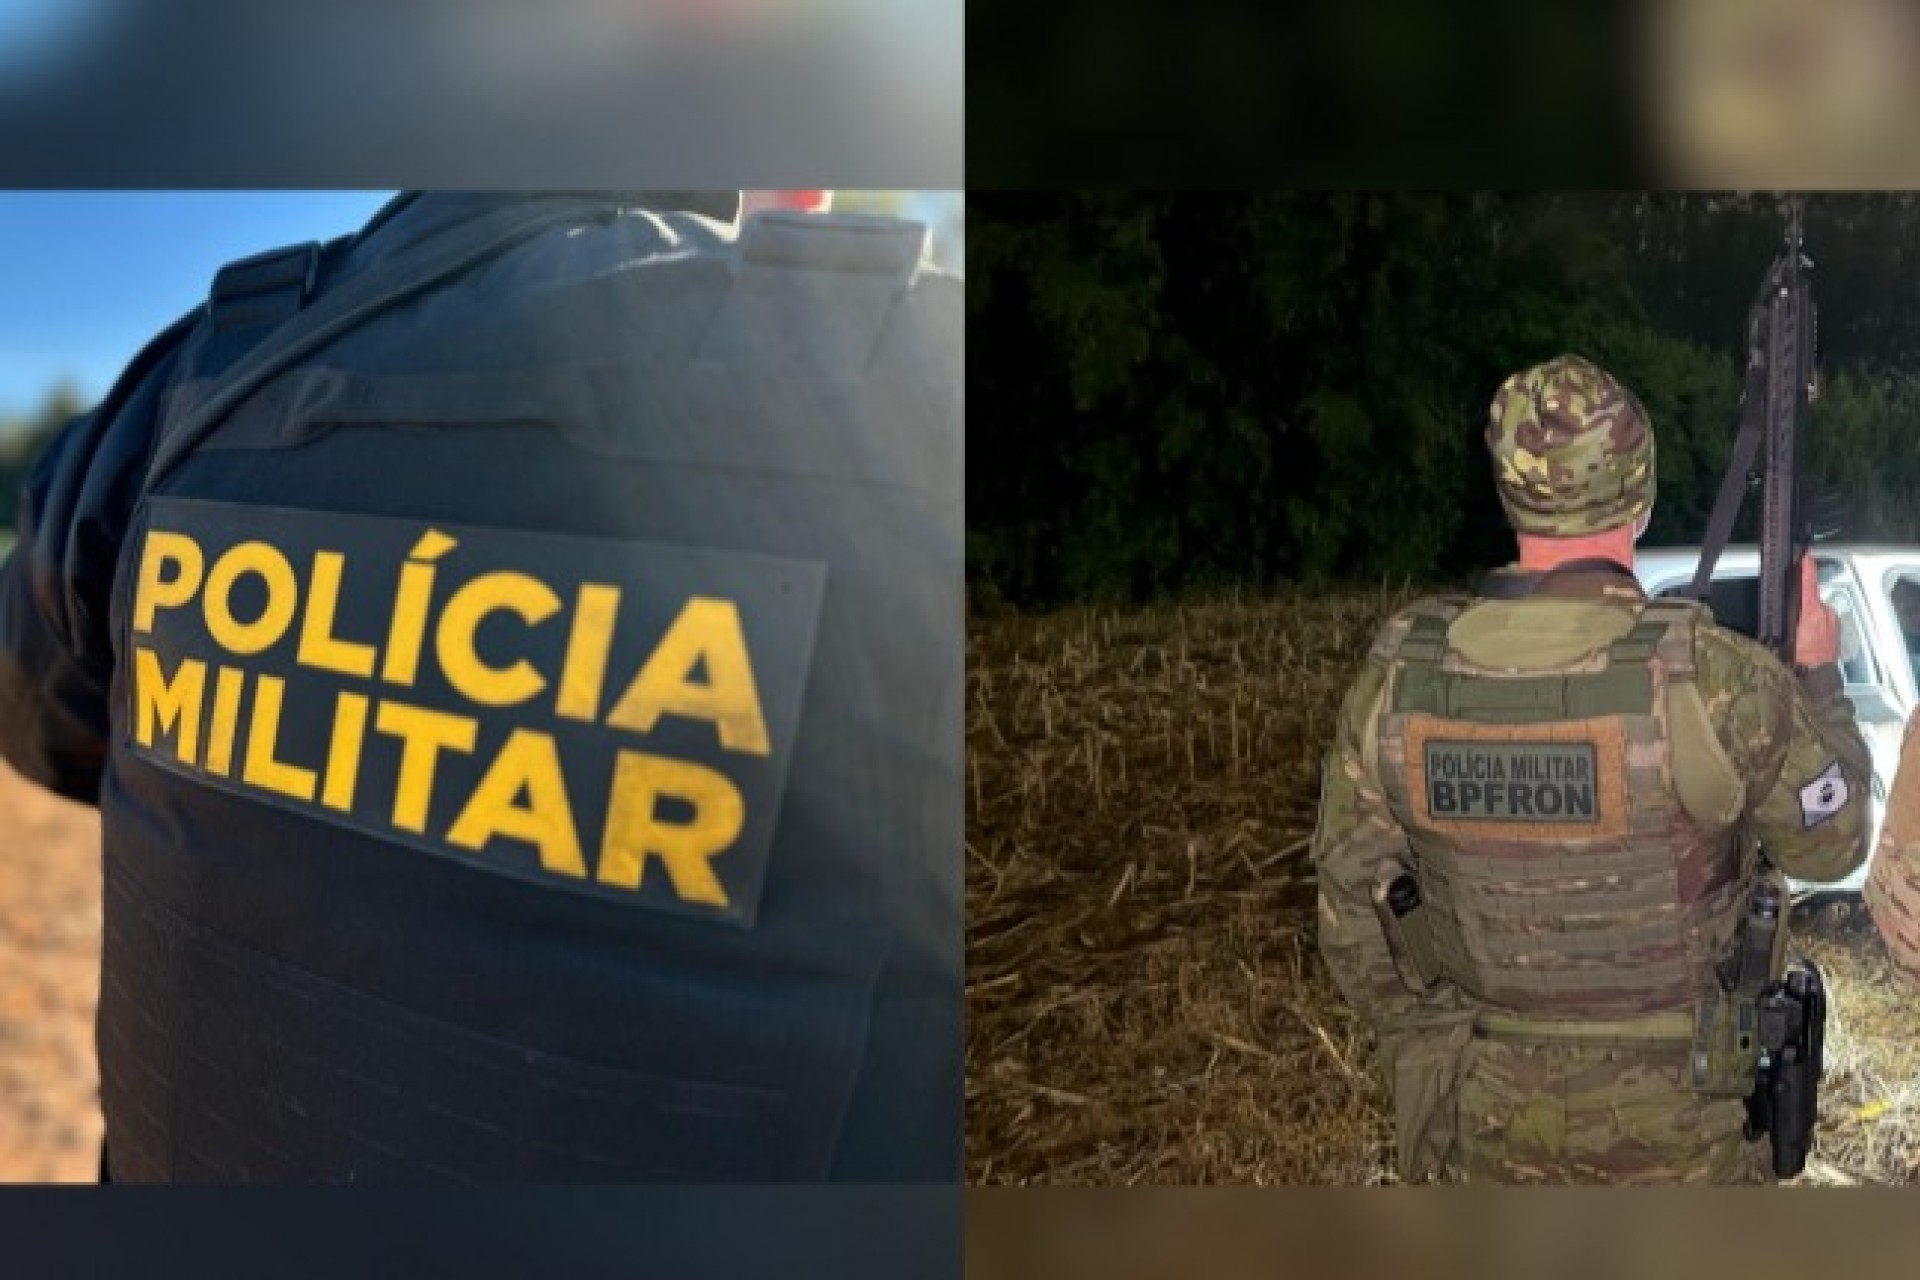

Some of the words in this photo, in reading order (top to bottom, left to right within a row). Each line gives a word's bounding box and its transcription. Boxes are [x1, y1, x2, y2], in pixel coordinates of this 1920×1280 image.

[132, 529, 771, 756] POLÍCIA
[133, 647, 746, 908] MILITAR
[1430, 750, 1505, 779] POLÍCIA
[1511, 755, 1590, 781] MILITAR
[1434, 781, 1592, 814] BPFRON
